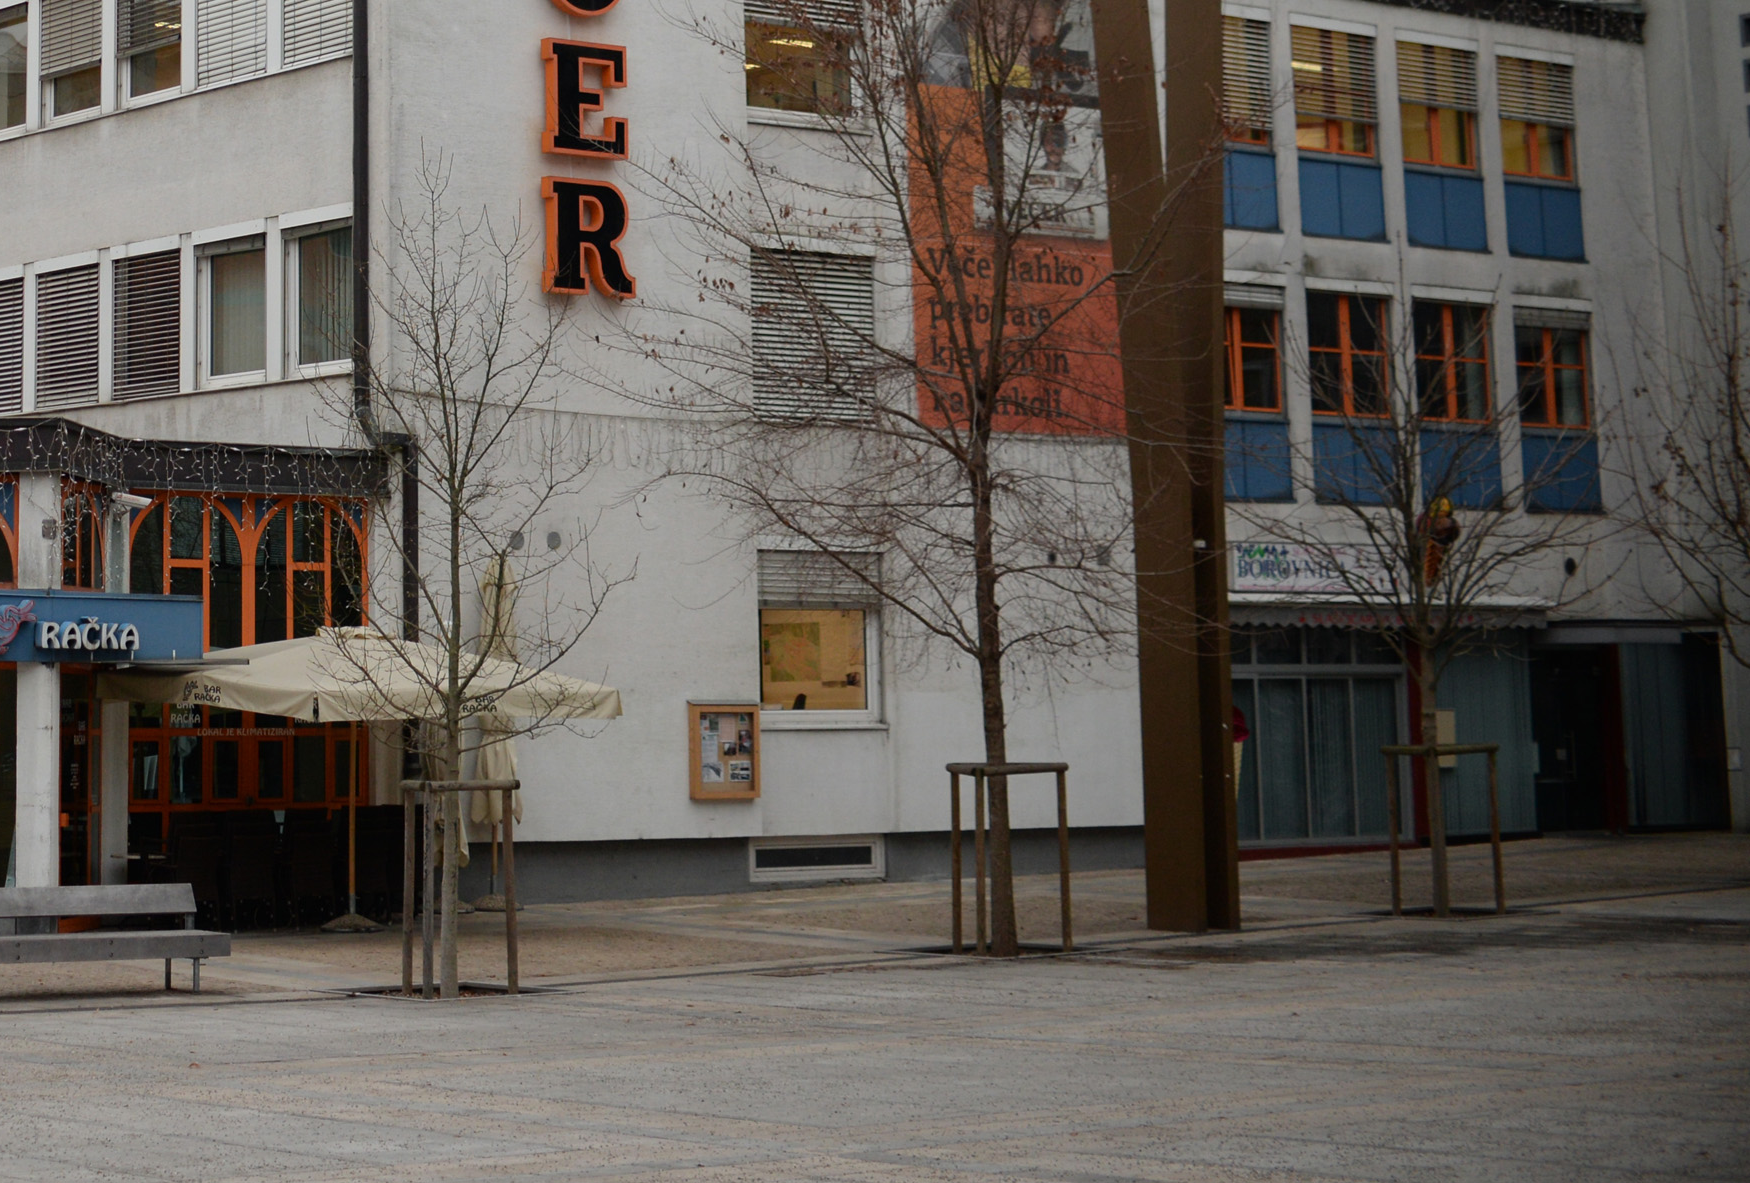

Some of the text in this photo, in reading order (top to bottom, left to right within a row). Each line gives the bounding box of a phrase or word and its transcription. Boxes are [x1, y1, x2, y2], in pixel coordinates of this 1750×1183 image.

[927, 247, 1084, 286] Vče lahko
[929, 295, 1052, 329] prbrate
[931, 336, 1035, 373] kjeroli
[933, 384, 1069, 420] karkoli.
[39, 616, 140, 651] RAČKA
[194, 693, 221, 704] RAČKA
[203, 684, 222, 694] BAR
[170, 710, 201, 724] RAČKA
[197, 727, 296, 737] LOKAL JE KLIMATIZIRAN
